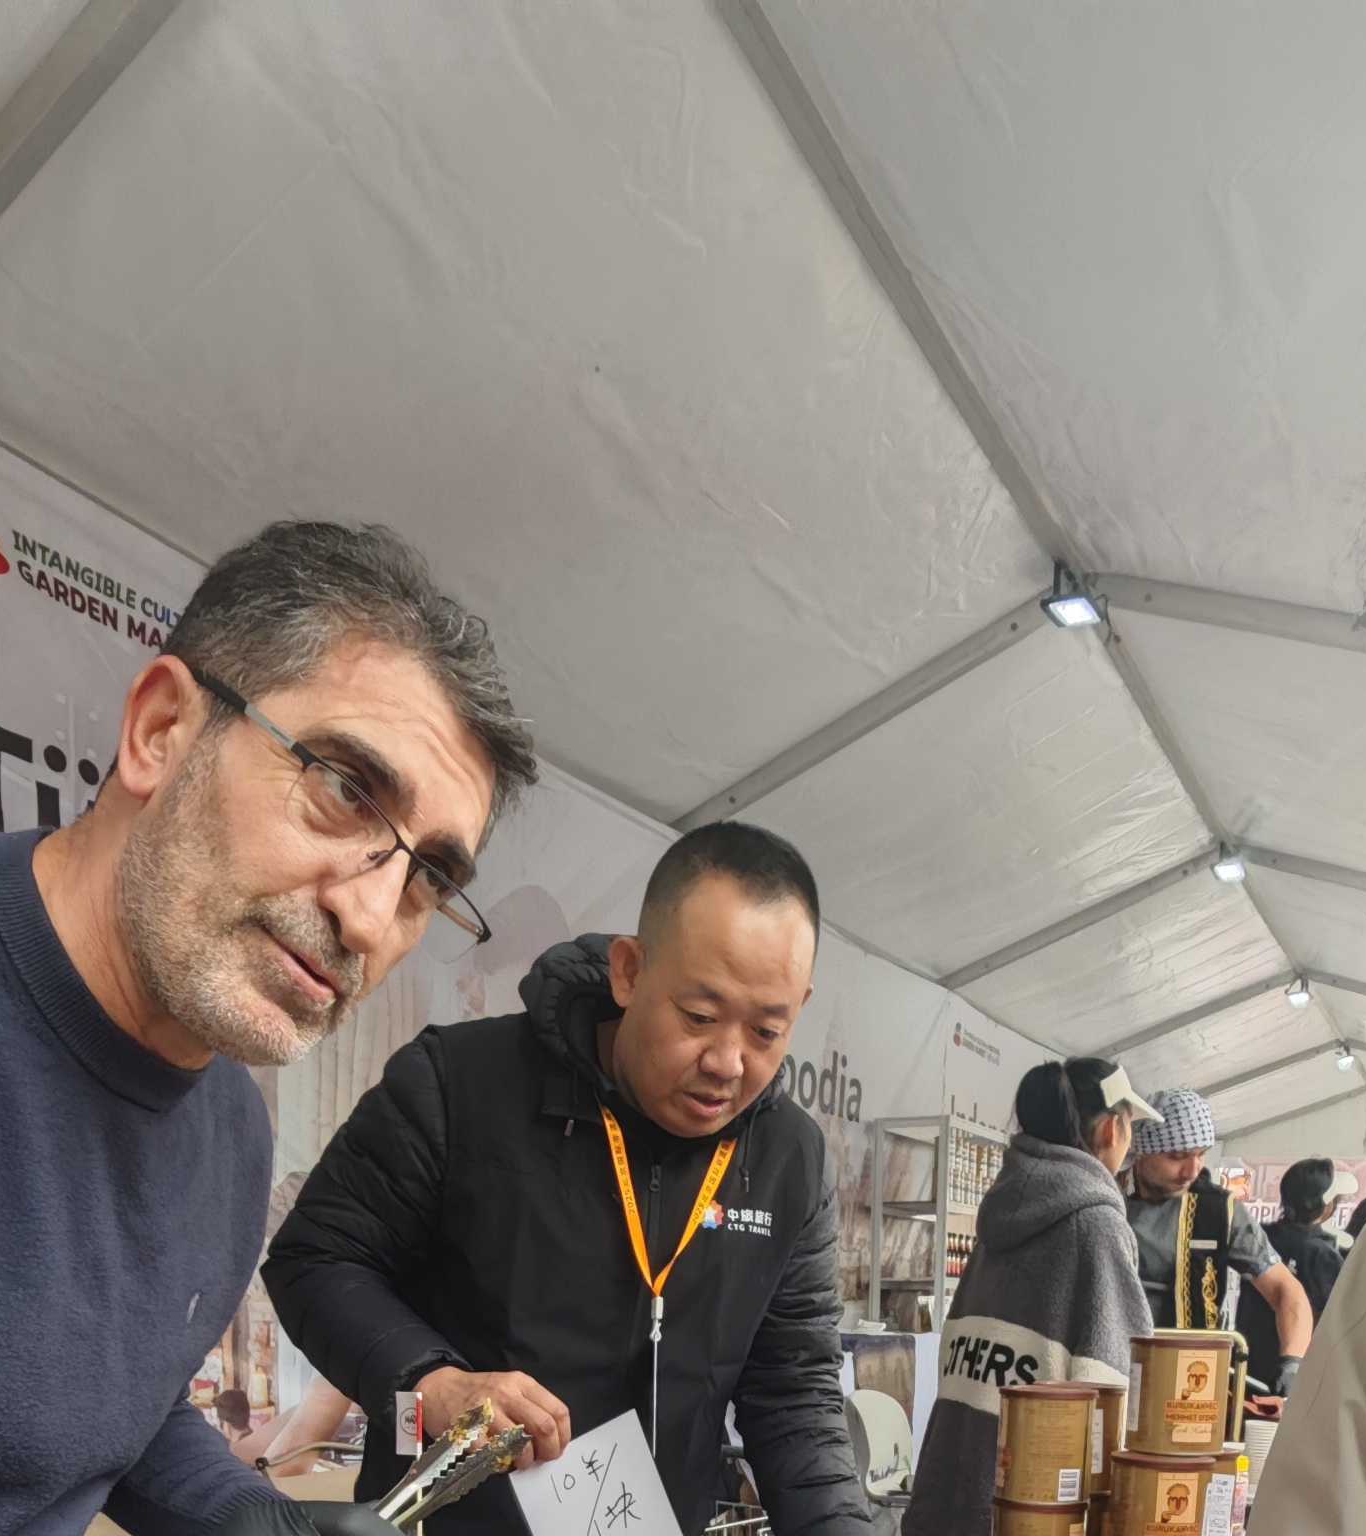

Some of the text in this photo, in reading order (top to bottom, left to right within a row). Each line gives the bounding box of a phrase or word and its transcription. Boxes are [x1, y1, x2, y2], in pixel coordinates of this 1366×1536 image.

[11, 529, 136, 610] INTANGIBLE
[17, 560, 119, 632] GARDEN
[727, 1208, 772, 1226] 中旅旅行
[727, 1223, 771, 1237] CTG TRAVEL
